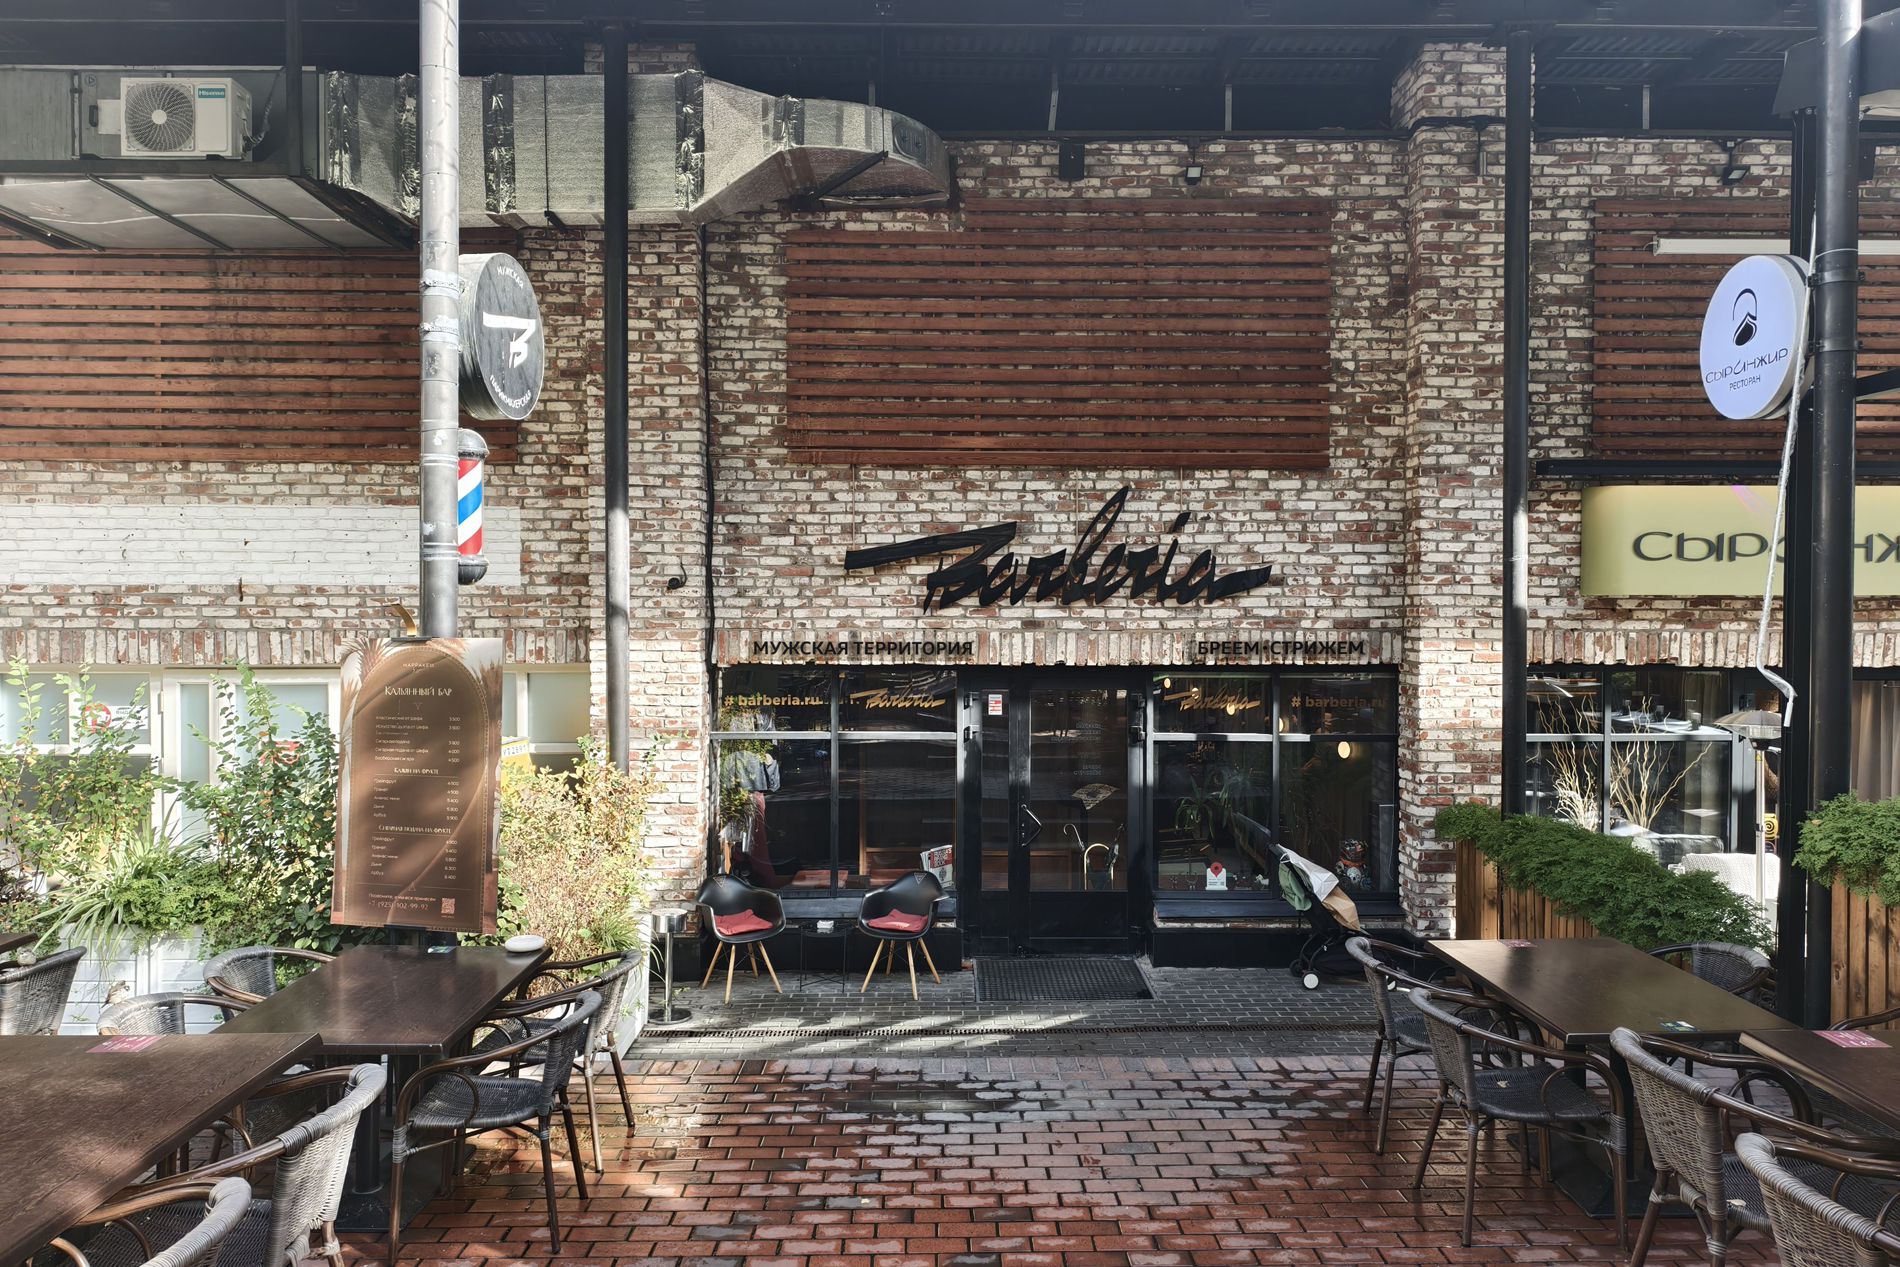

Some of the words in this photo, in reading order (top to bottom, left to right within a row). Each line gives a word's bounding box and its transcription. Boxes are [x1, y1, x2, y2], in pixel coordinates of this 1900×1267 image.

[1729, 374, 1761, 391] РЕСТОРАН
[844, 486, 1272, 615] Barberia
[753, 641, 848, 655] МУЖСКАЯ
[853, 641, 974, 656] ТЕРРИТОРИЯ
[738, 693, 821, 706] barberia.ru
